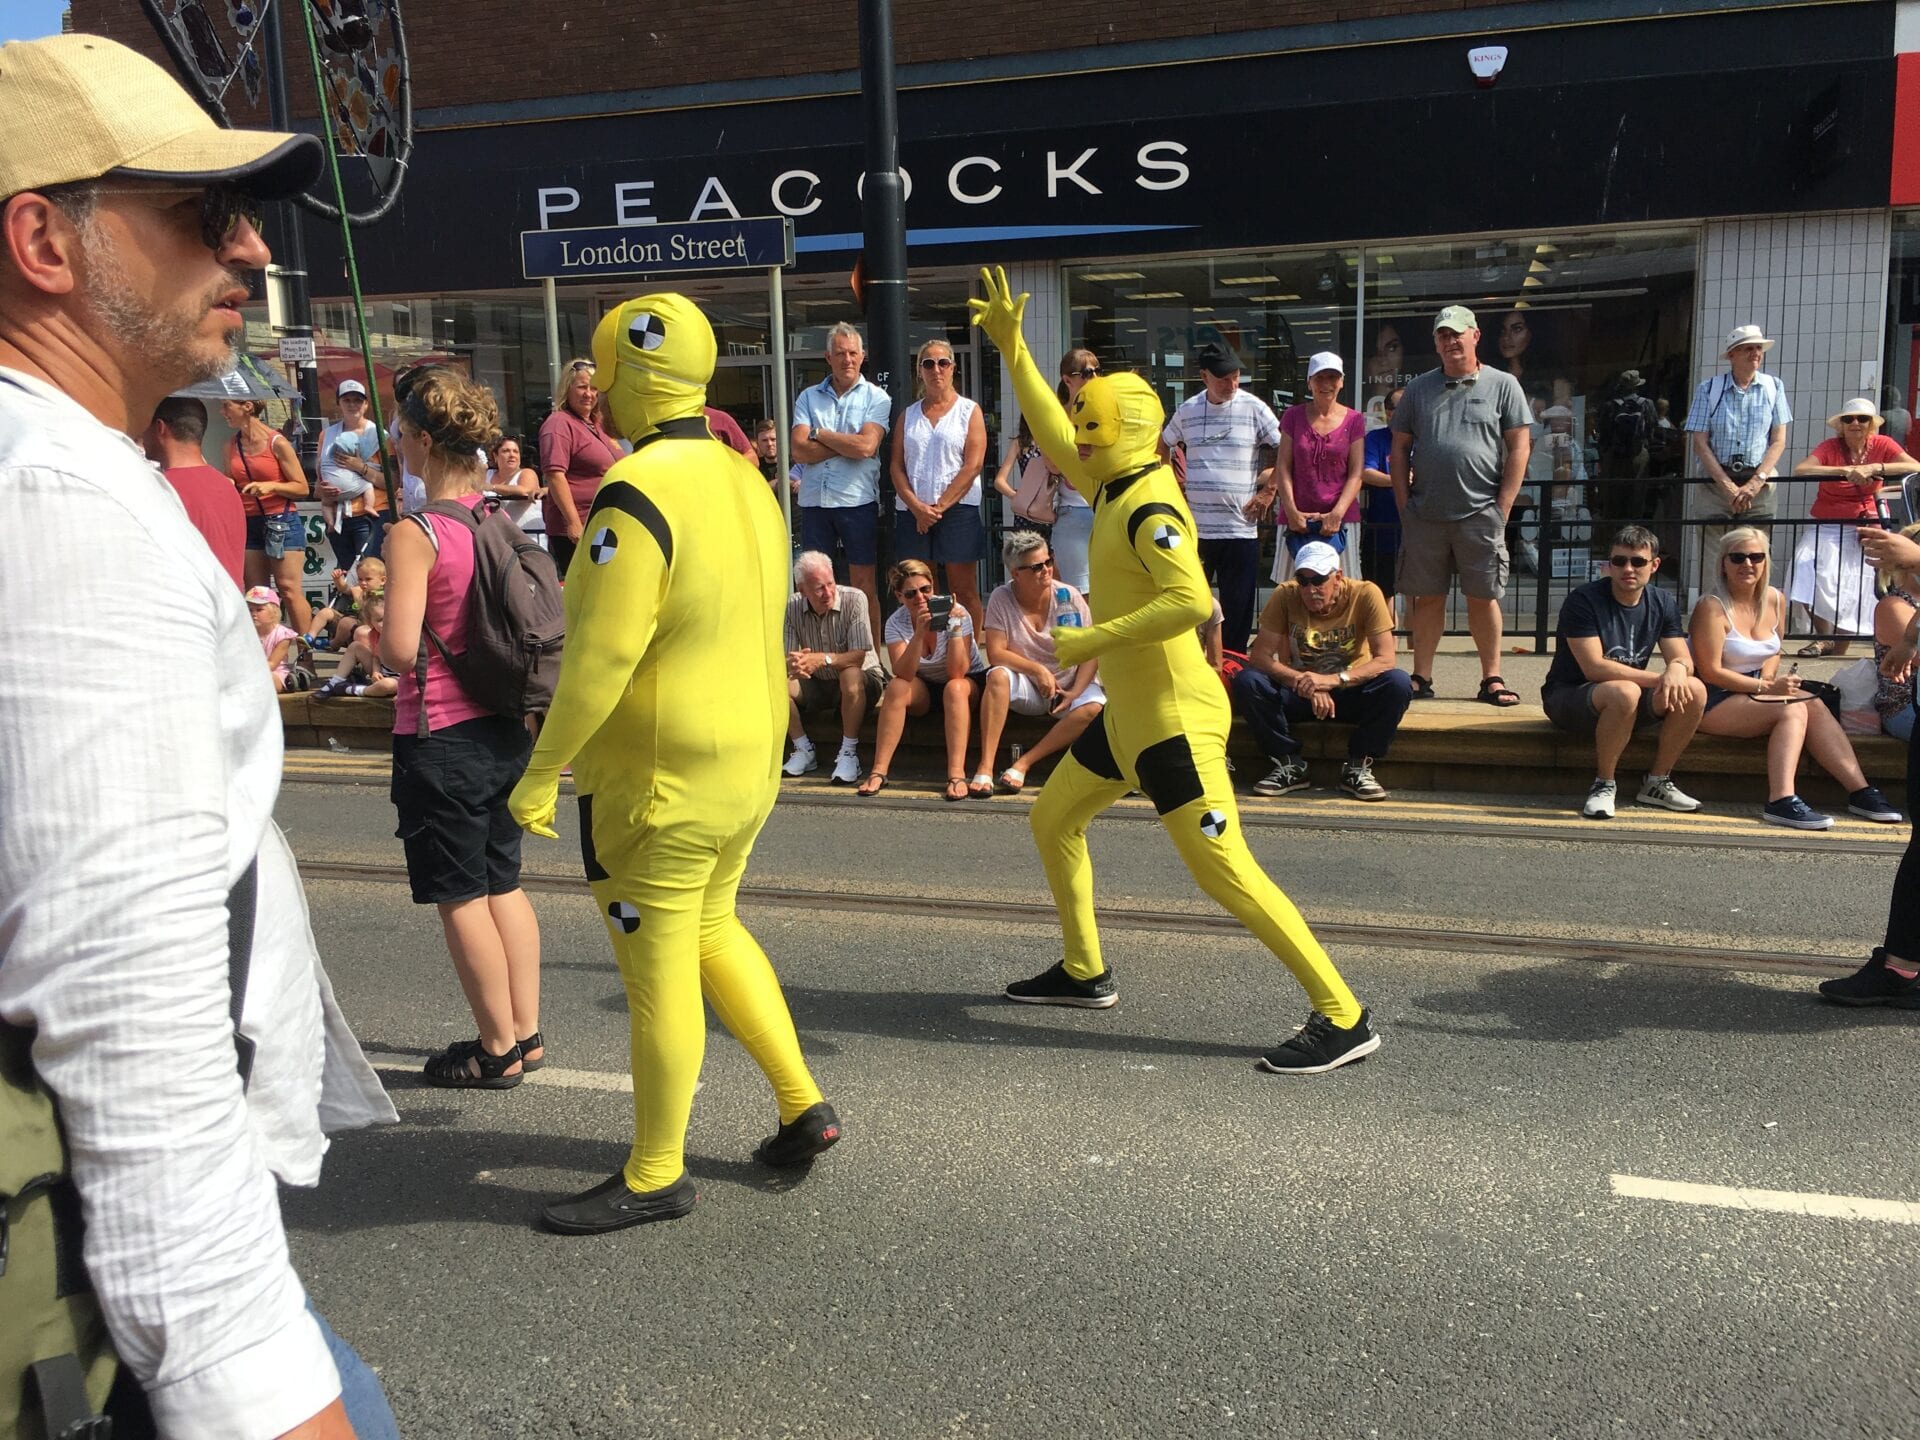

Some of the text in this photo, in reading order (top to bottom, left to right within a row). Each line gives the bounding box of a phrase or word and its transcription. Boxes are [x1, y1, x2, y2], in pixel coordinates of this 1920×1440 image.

[1473, 54, 1502, 63] KINGS
[560, 232, 747, 268] London Street
[877, 371, 890, 382] CF
